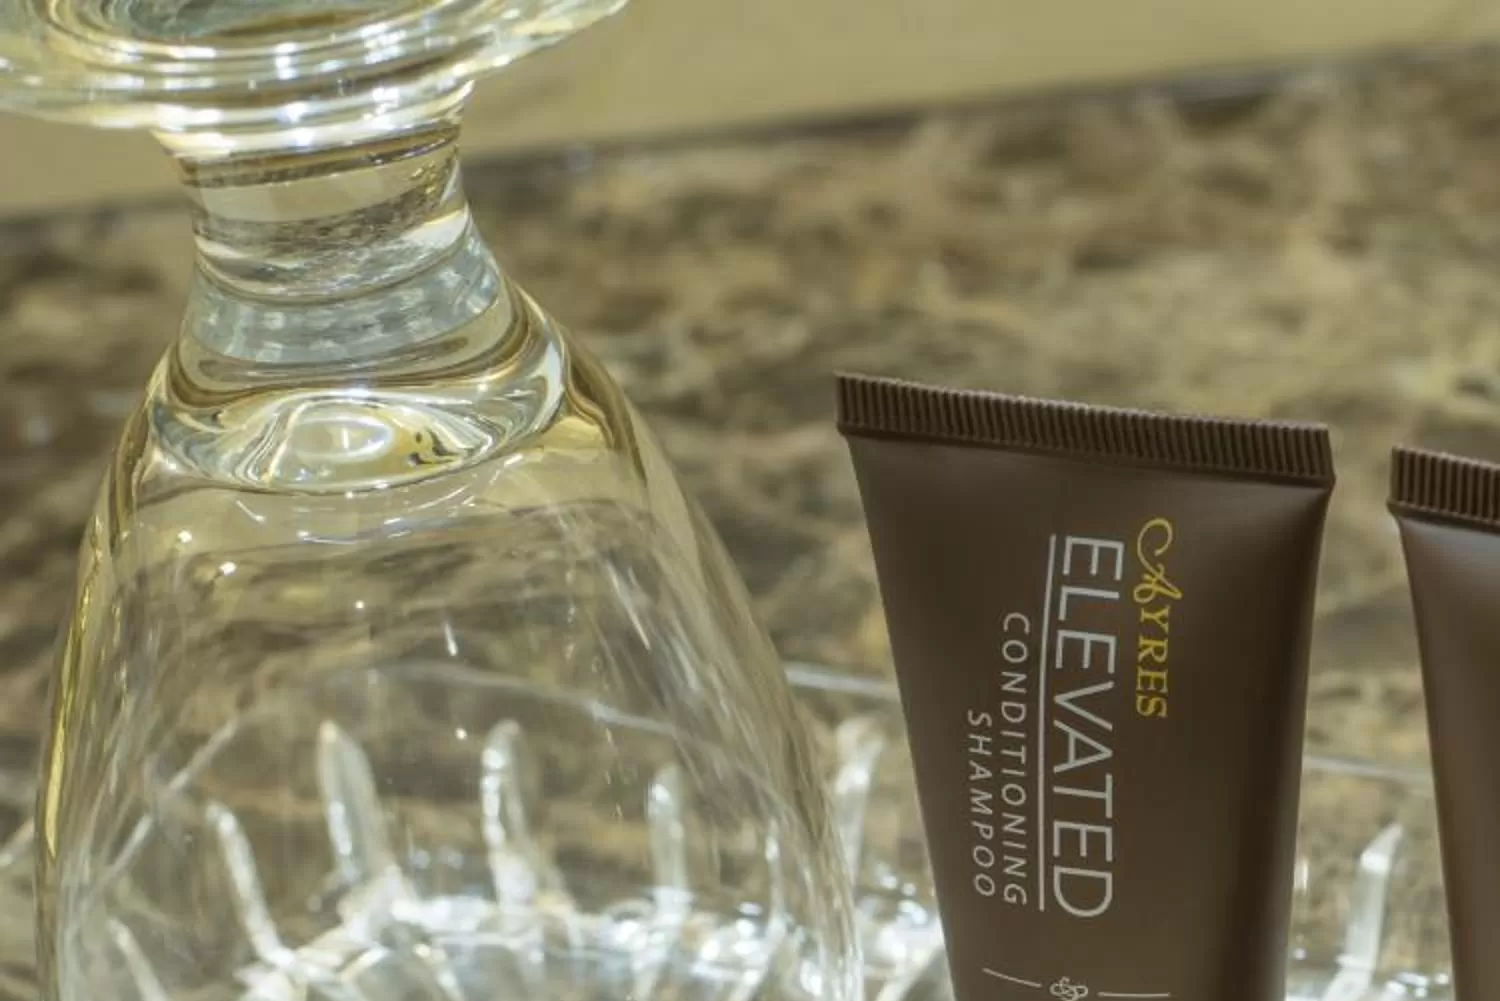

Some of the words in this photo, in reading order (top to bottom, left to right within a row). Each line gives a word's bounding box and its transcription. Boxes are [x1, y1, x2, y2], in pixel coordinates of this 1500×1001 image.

[1052, 534, 1124, 918] ELEVATED
[1133, 517, 1182, 718] AYRES
[967, 709, 995, 898] SHAMPOO
[1000, 611, 1030, 906] CONDITIONING
